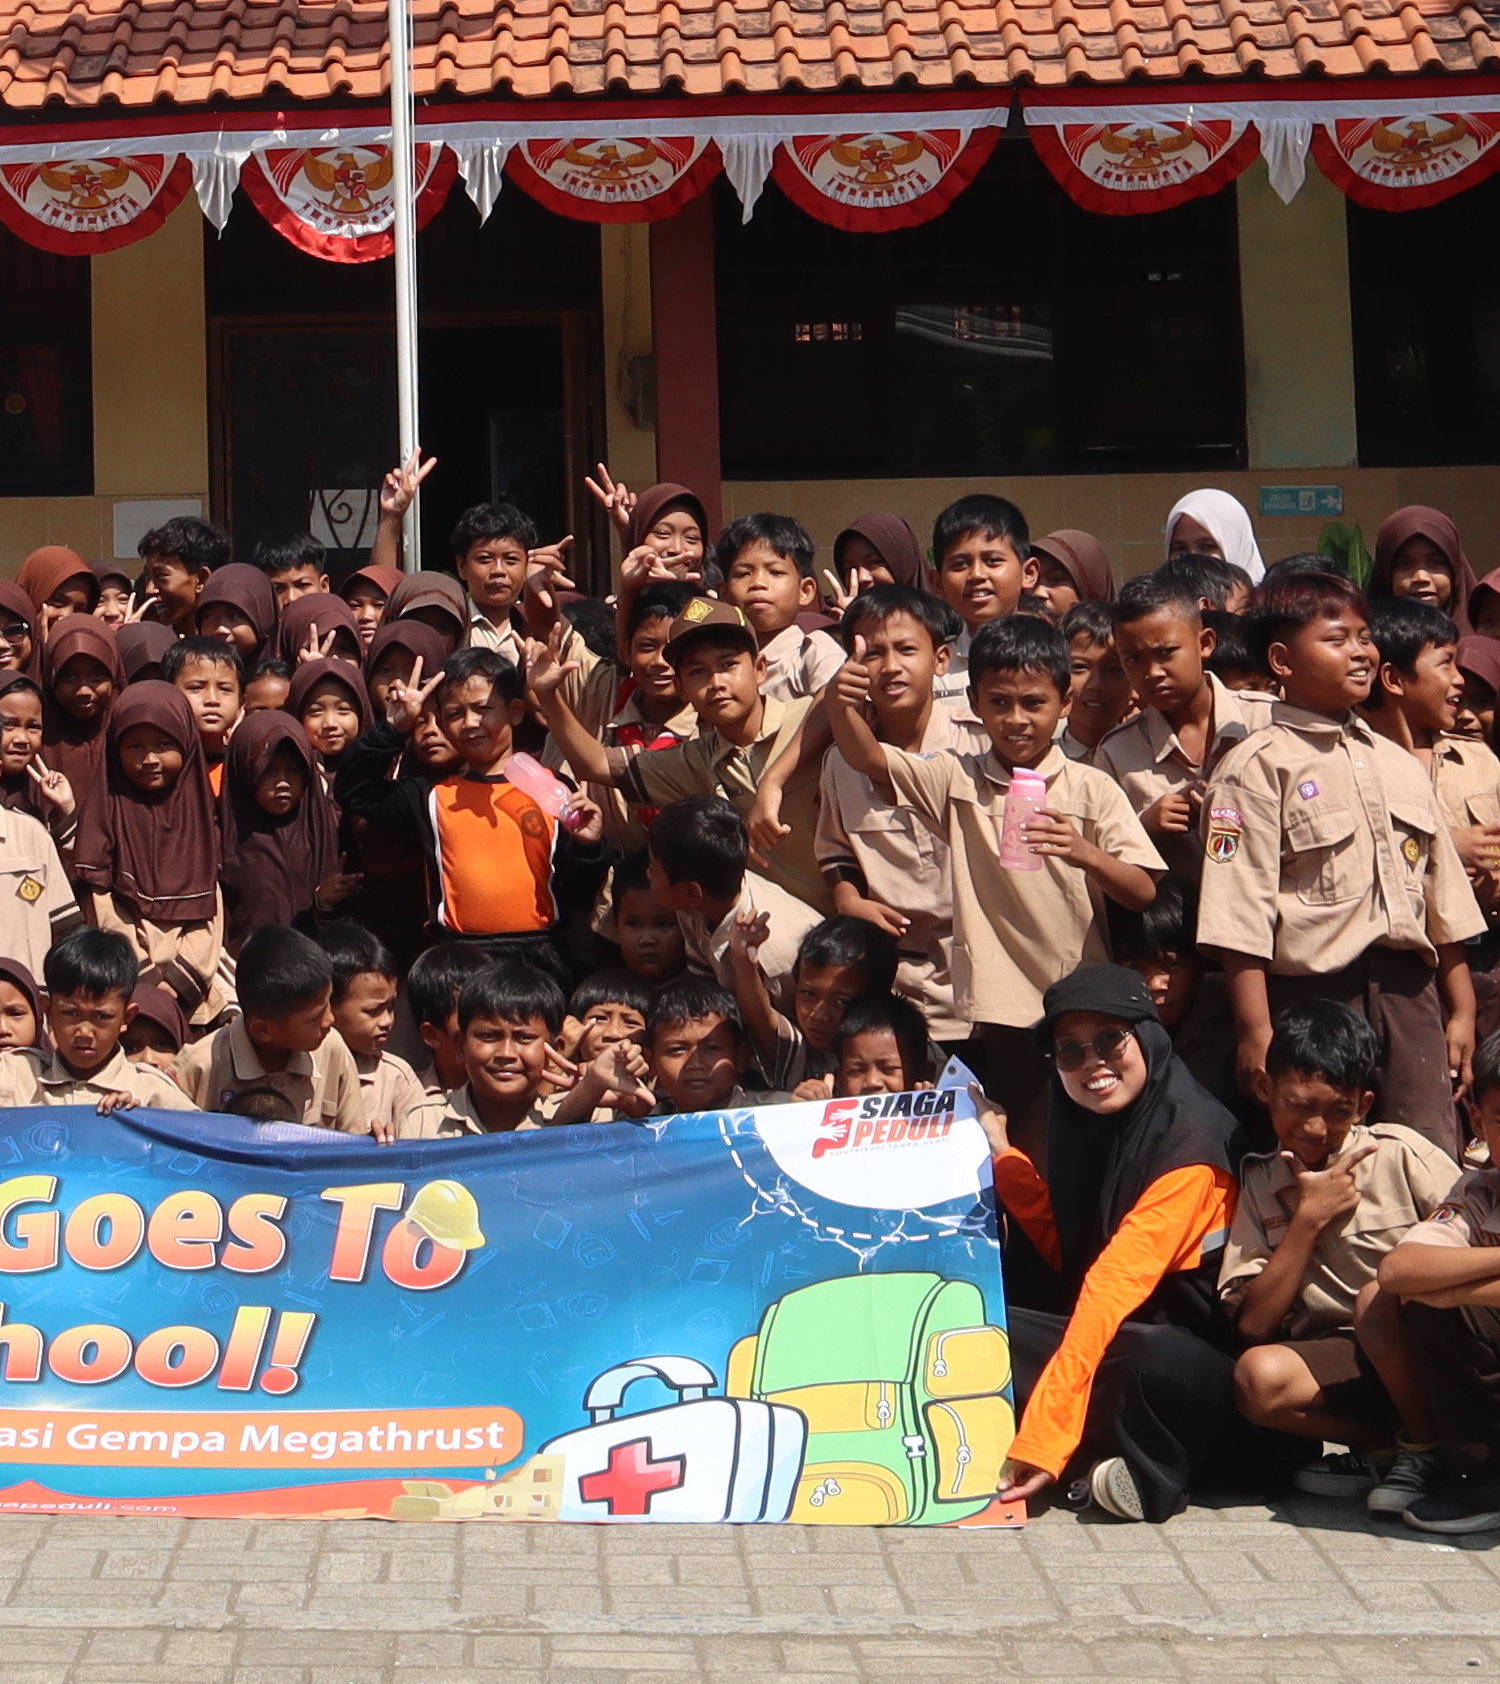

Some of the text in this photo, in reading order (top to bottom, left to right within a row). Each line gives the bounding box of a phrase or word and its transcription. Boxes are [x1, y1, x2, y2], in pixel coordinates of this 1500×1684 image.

[859, 1089, 957, 1119] SIAGA
[852, 1112, 955, 1148] PEDULI
[66, 1422, 226, 1459] Gempa
[239, 1421, 505, 1460] Megathrust
